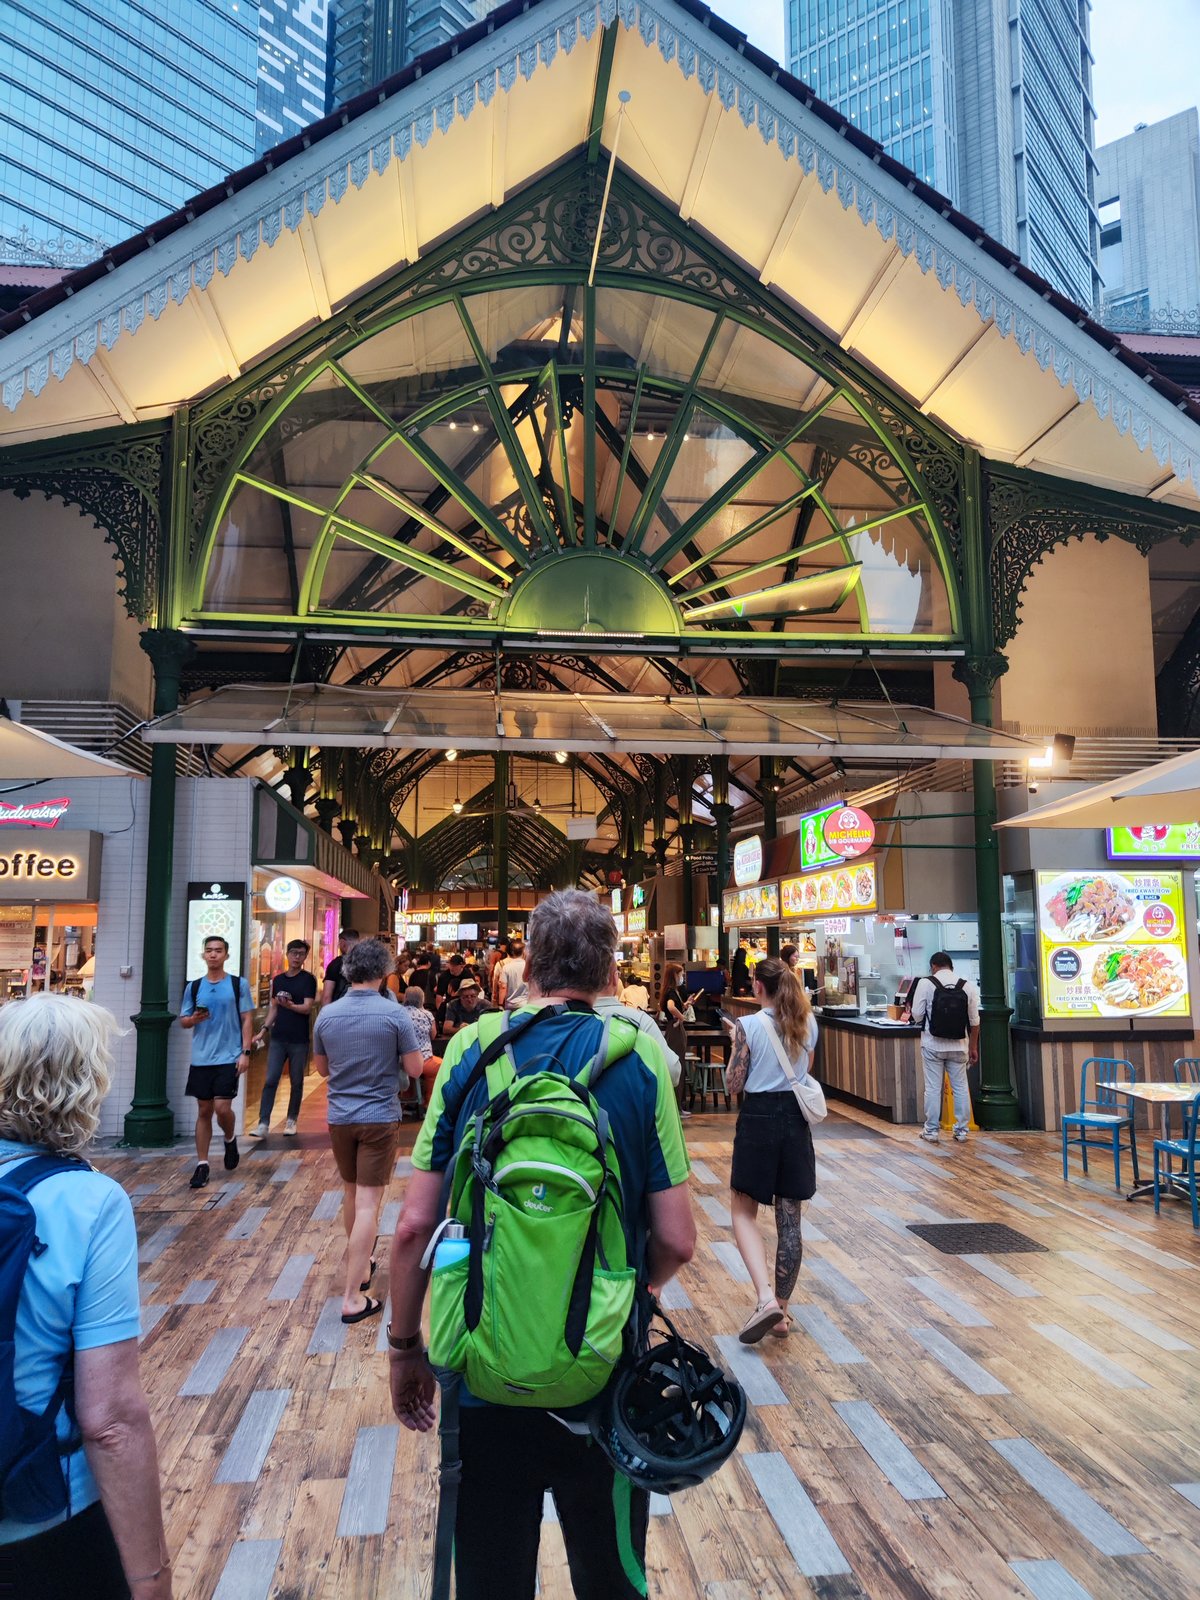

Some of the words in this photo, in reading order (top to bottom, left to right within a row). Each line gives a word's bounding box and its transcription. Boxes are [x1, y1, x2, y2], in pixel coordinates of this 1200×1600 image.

[0, 805, 67, 819] udweiser
[829, 830, 871, 839] MICHELIN
[524, 1199, 553, 1212] deuter
